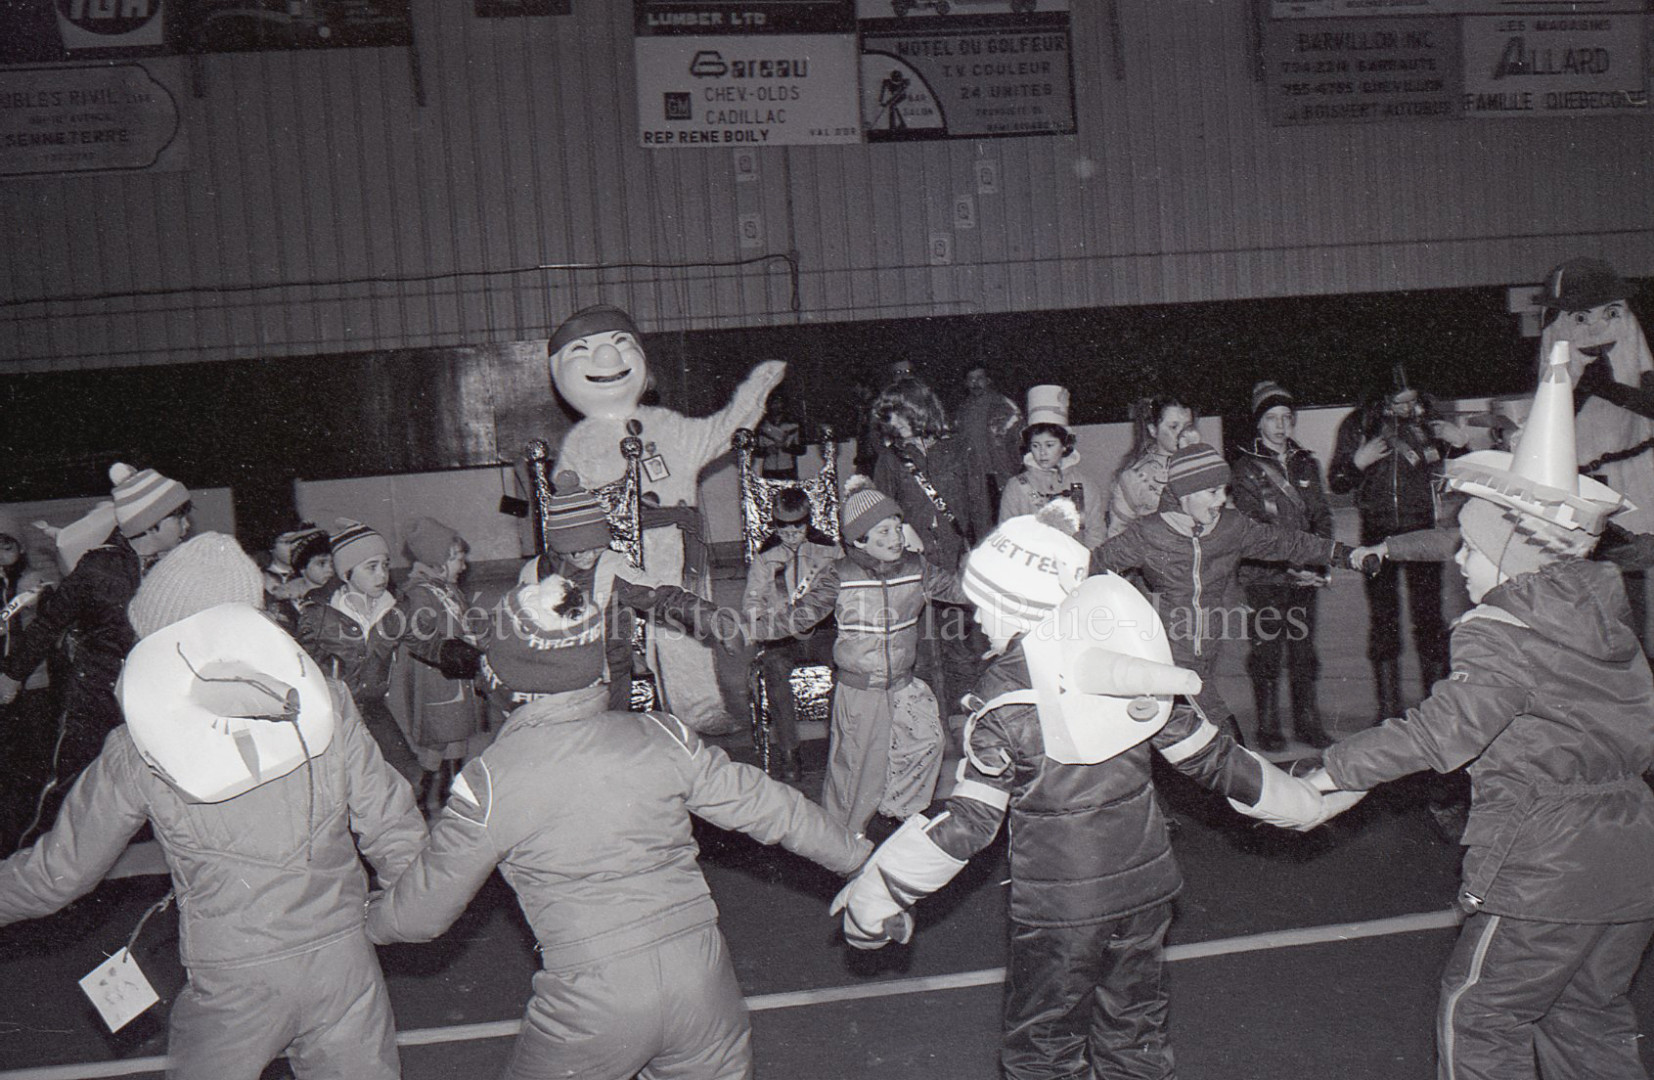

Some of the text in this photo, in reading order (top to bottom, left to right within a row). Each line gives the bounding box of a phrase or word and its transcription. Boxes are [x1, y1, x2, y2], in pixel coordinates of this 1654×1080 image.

[647, 12, 767, 26] LUMBER LTD
[1496, 19, 1612, 32] LES MAGASINS
[959, 39, 981, 56] DU
[987, 36, 1067, 55] GOLFEUR
[1493, 36, 1610, 80] ALLARD
[972, 62, 1052, 77] COULEUR
[960, 83, 1053, 100] 24 UNITES
[1463, 92, 1534, 111] FAMILLE
[706, 109, 787, 125] CADILLAC
[679, 131, 720, 144] RENE
[724, 130, 770, 143] BOILY
